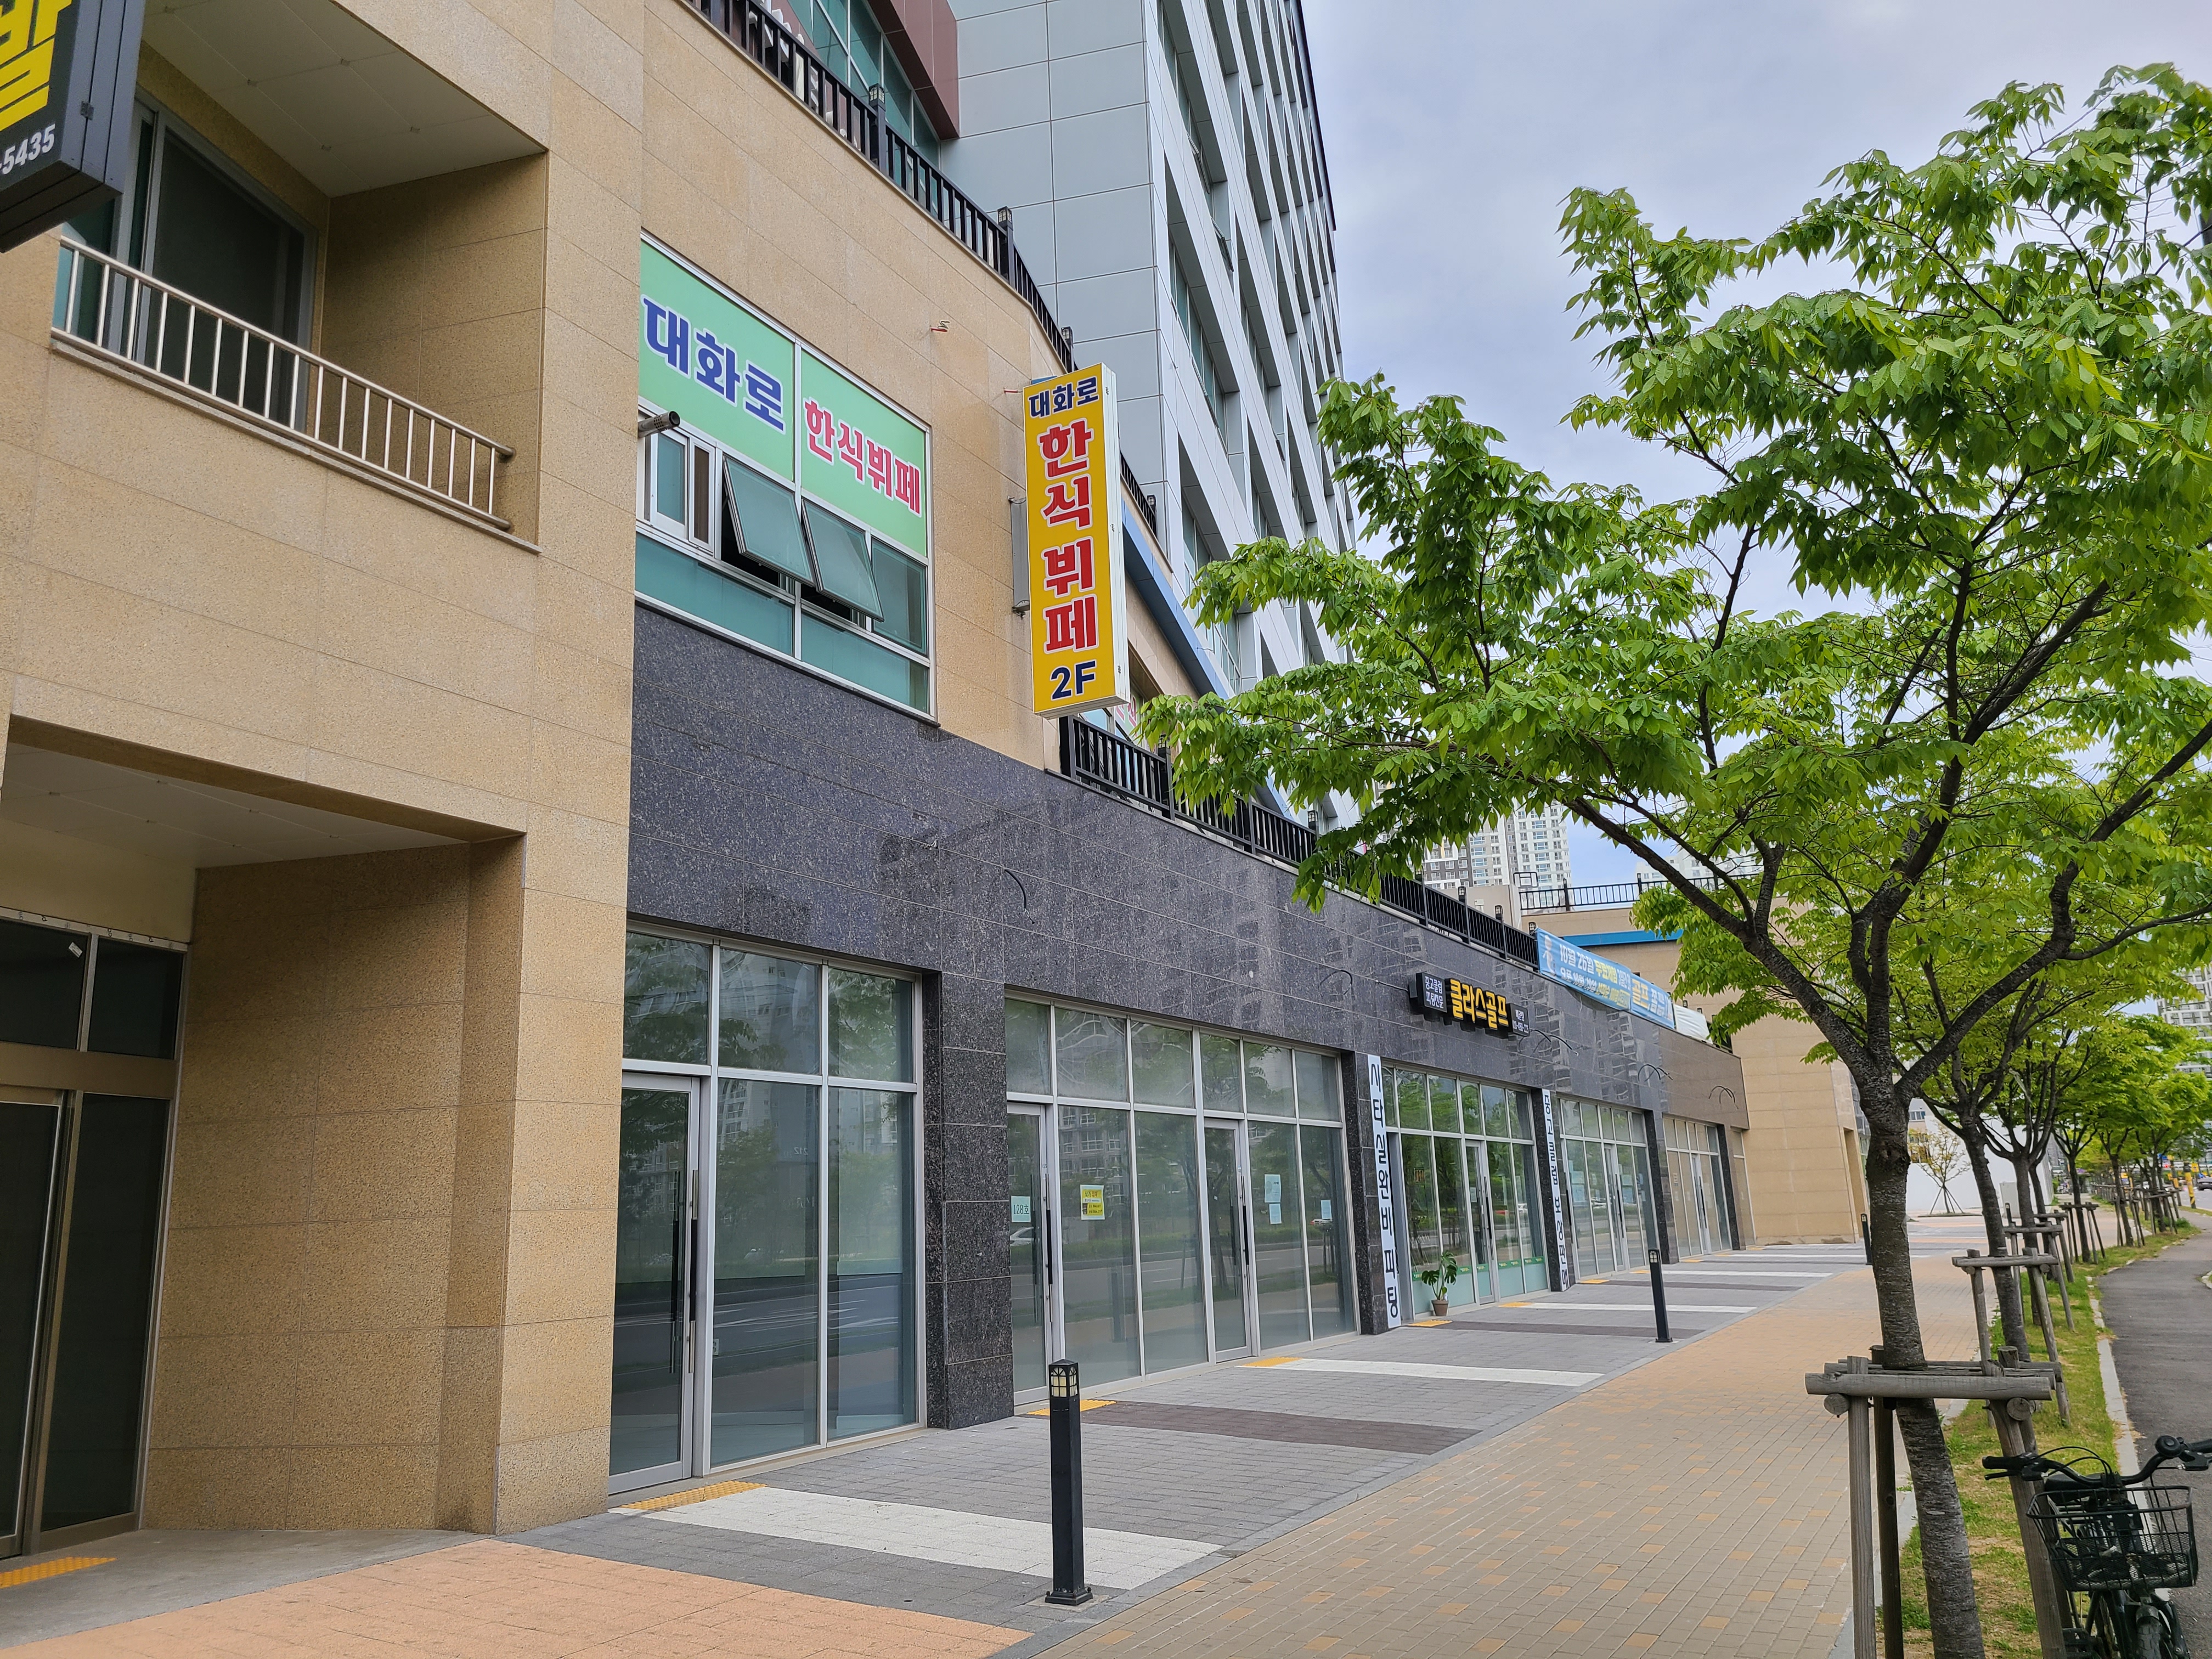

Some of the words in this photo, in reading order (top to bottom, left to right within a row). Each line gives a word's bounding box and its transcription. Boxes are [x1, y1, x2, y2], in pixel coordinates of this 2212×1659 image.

[642, 296, 785, 432] 대화로
[803, 399, 921, 516] 한식뷔페
[1029, 376, 1099, 417] 대화로
[1051, 660, 1097, 700] 2F
[1559, 944, 1576, 967] 10월
[1576, 952, 1595, 975] 26일
[1560, 967, 1573, 983] 오픈
[1425, 975, 1443, 995] 중고클럽
[1425, 991, 1444, 1009] 피팅전문
[1450, 979, 1509, 1030] 클라스골프
[1544, 1094, 1558, 1185] 중고클럽
[1013, 1204, 1030, 1215] 128호
[1384, 1250, 1399, 1318] 피팅
